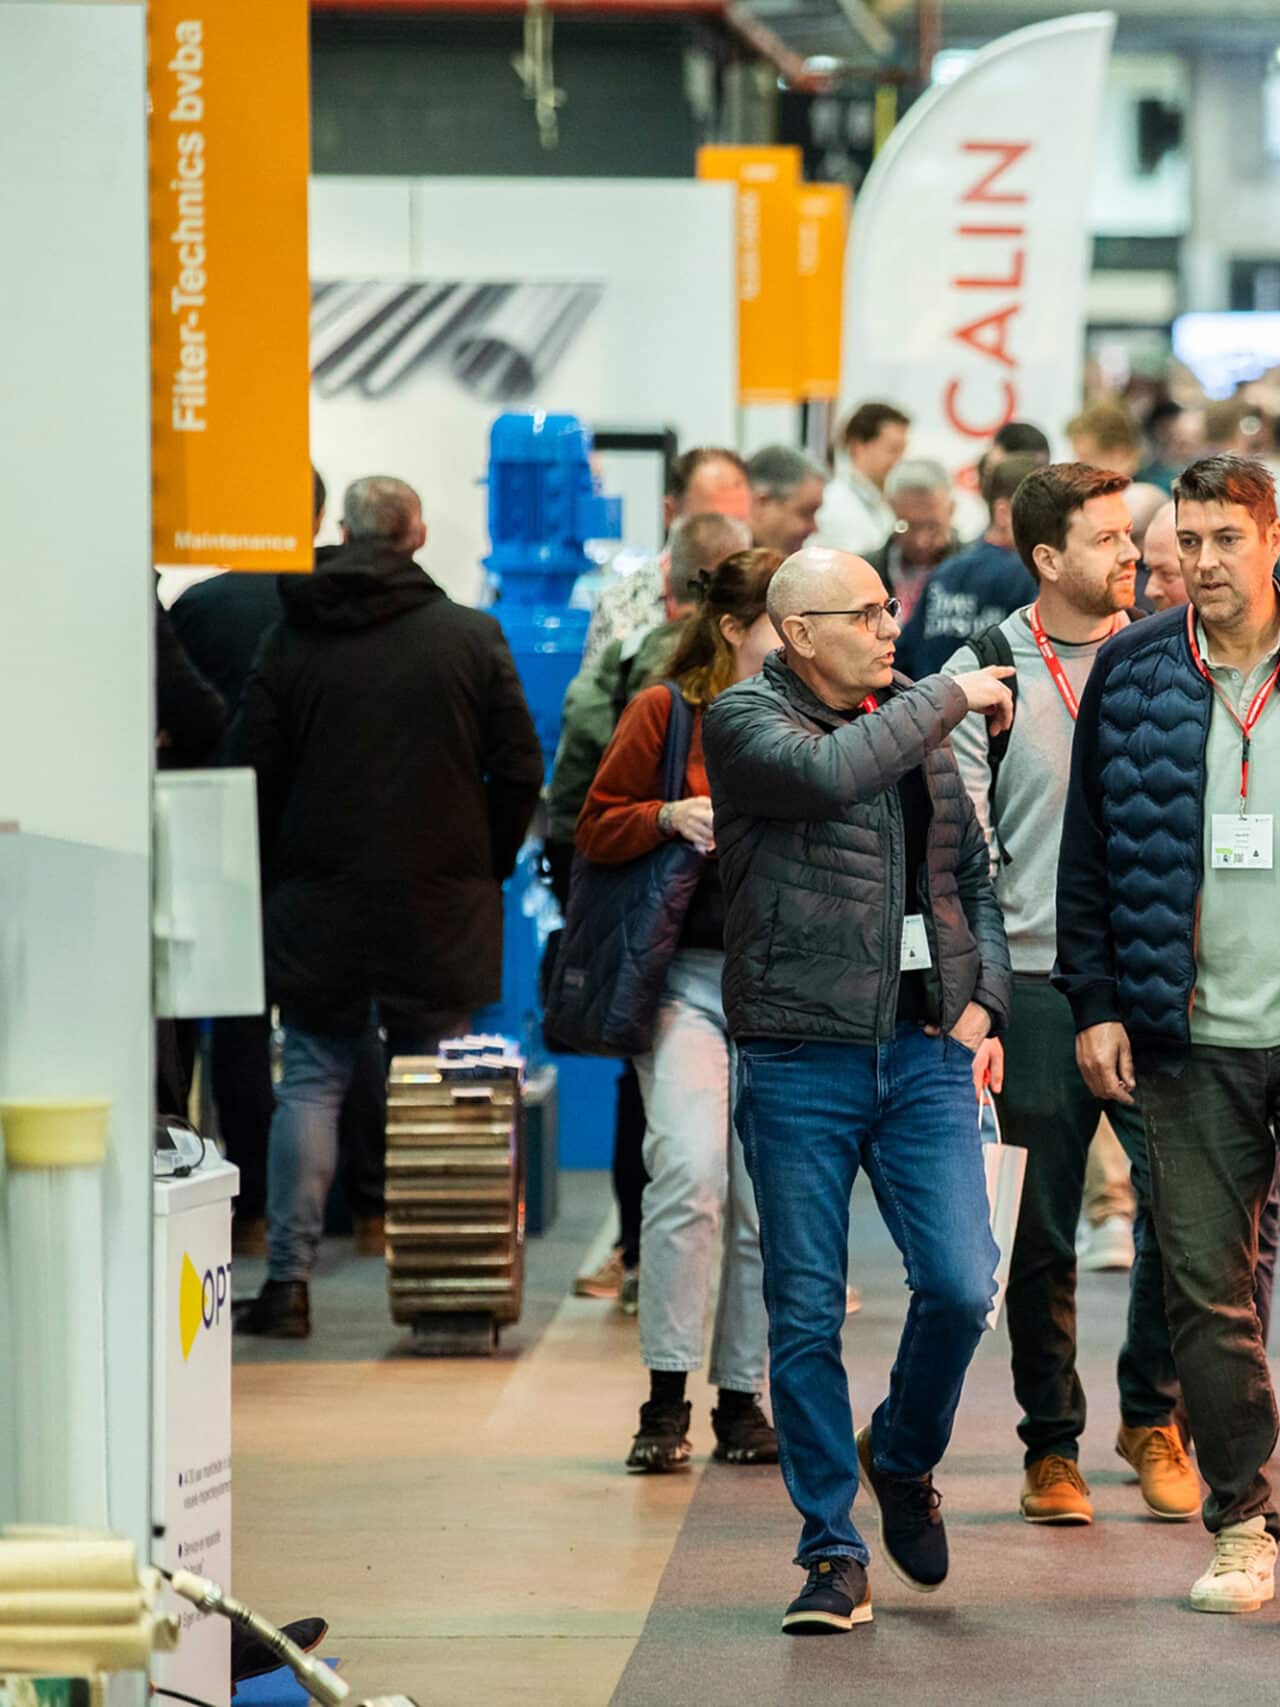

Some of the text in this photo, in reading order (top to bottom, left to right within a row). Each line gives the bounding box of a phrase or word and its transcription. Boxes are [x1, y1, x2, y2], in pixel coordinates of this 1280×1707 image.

[168, 19, 207, 432] Filter-Technics bvba
[943, 142, 1032, 492] CALIN
[174, 530, 297, 551] Maintenance
[201, 1263, 232, 1331] OP
